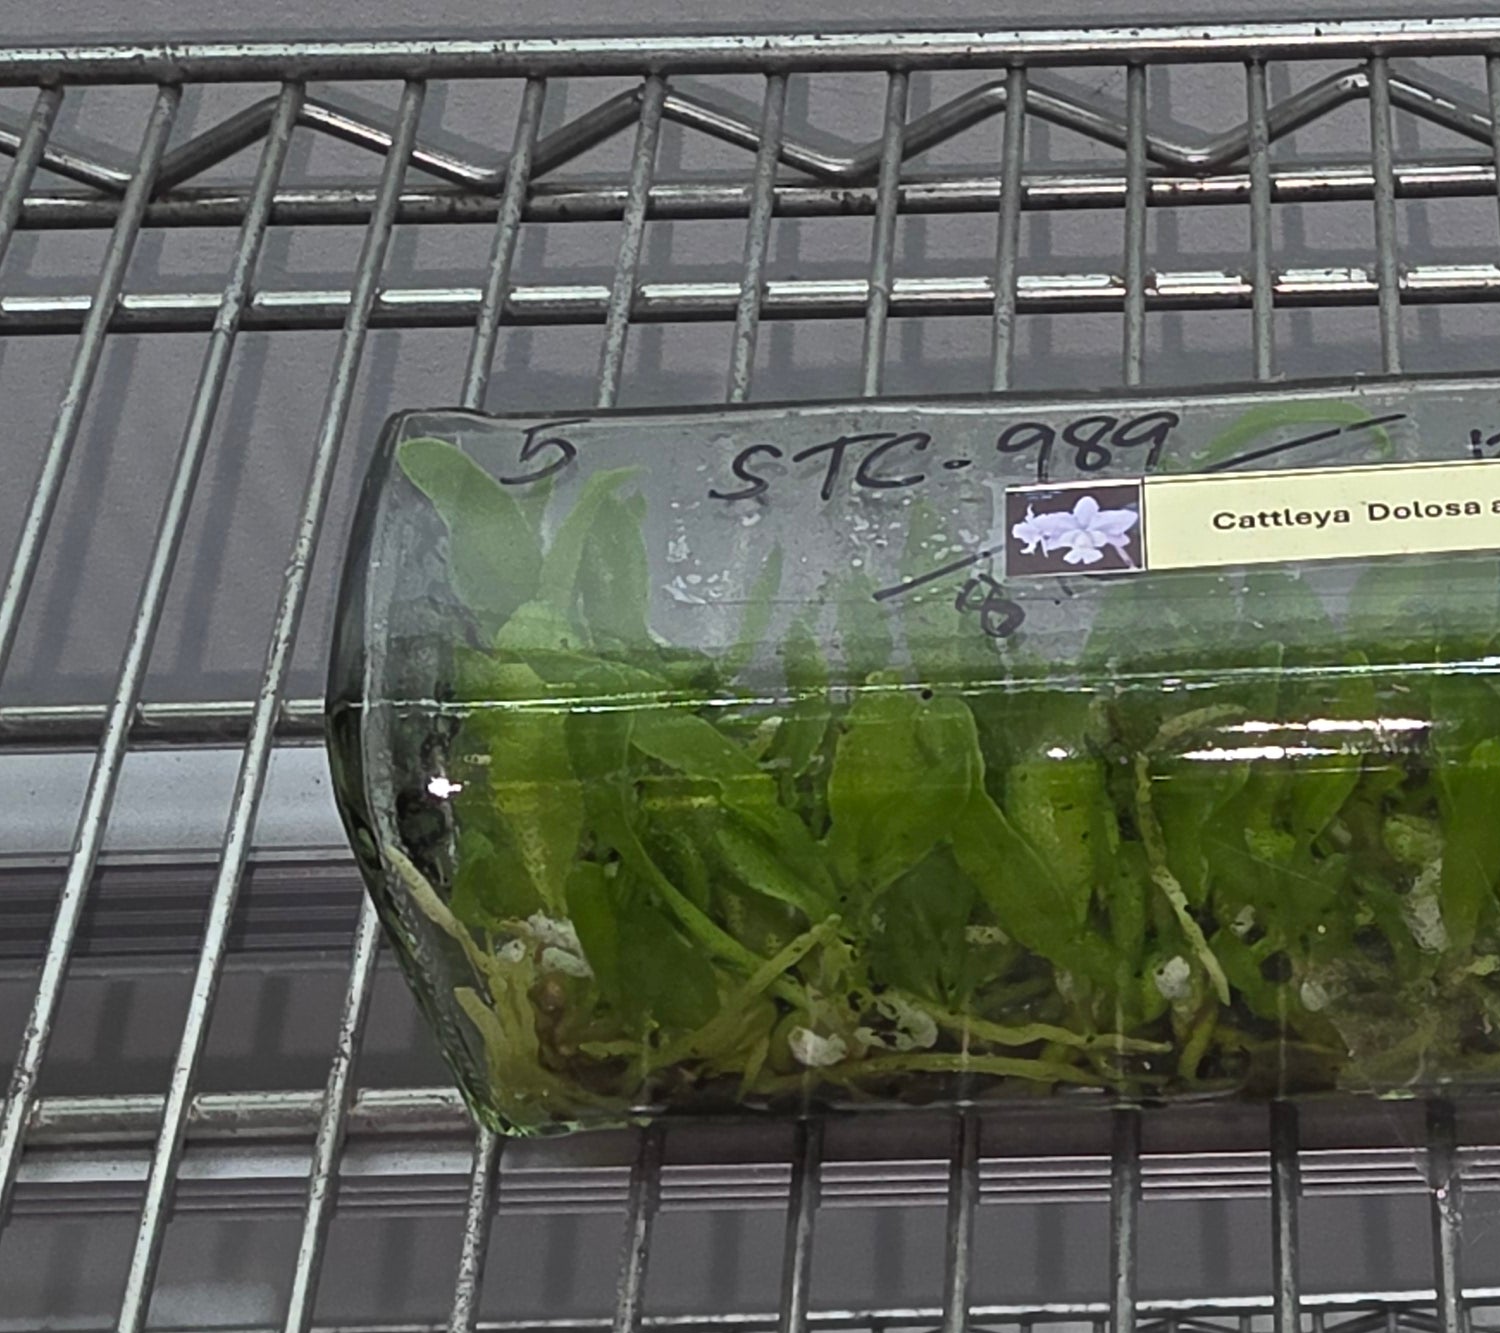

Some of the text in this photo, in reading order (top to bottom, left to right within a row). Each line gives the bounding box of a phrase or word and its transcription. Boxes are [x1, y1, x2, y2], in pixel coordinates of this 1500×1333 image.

[499, 418, 591, 485] 5
[1212, 507, 1351, 531] Cattleya
[1367, 501, 1482, 521] Dolosa
